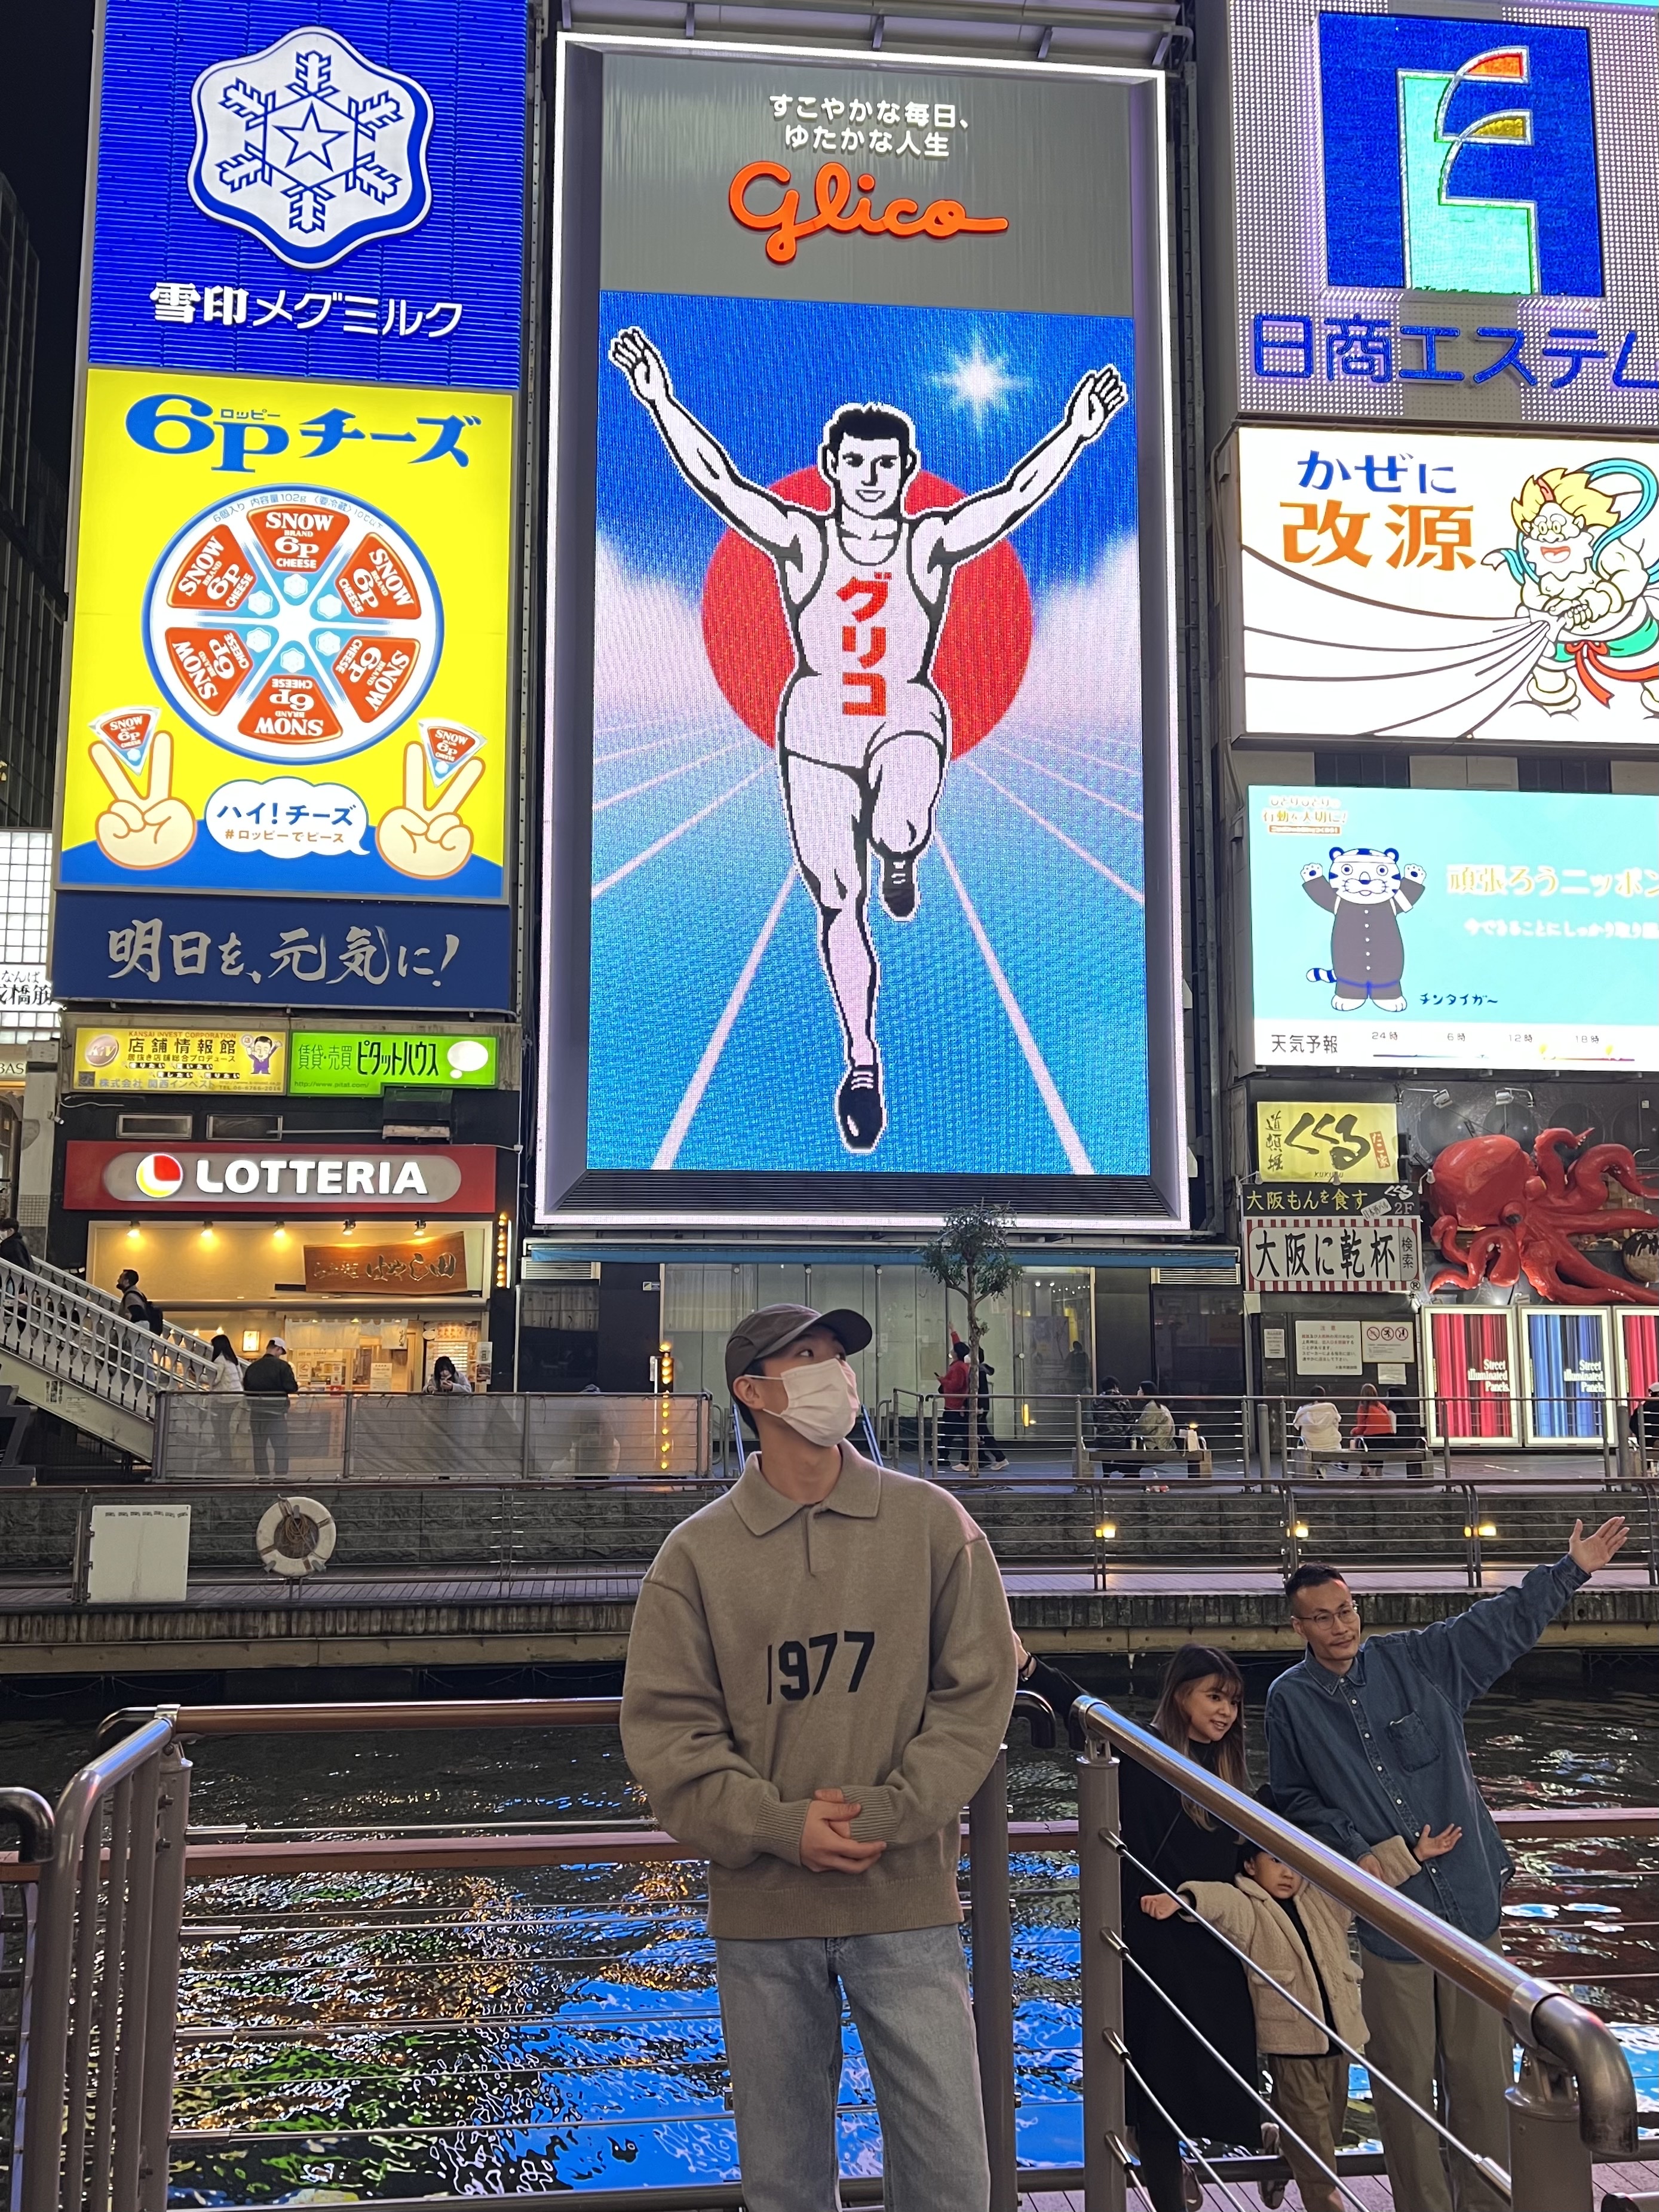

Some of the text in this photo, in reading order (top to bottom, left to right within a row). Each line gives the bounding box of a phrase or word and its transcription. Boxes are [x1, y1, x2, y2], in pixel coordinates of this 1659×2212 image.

[769, 94, 968, 130] すこやかな毎日、
[786, 124, 950, 158] ゆたかな人生
[729, 161, 1010, 263] Glico
[149, 281, 464, 338] 雪印メグミルク
[220, 409, 280, 421] ロッピー
[1297, 449, 1457, 494] かぜに
[213, 503, 246, 523] 6個入り
[266, 511, 334, 531] SNOW
[1280, 499, 1476, 572] 改源
[178, 535, 224, 597] SNOW
[275, 557, 317, 569] CHEESE
[368, 548, 415, 606] SNOW
[225, 572, 253, 608] CHEESE
[339, 578, 364, 615] CHEESE
[223, 632, 250, 669] CHEESE
[335, 639, 363, 674] CHEESE
[836, 572, 892, 717] グリコ
[172, 641, 218, 700] SNOW
[271, 678, 313, 689] CHEESE
[364, 649, 410, 712] SNOW
[109, 716, 143, 731] SNOW
[254, 717, 324, 737] SNOW
[435, 729, 469, 745] SNOW
[1, 970, 40, 984] なんば
[128, 1037, 236, 1054] 店舗情報館
[358, 1040, 439, 1076] ピタットハウス
[1271, 1034, 1338, 1054] 天気予報
[99, 1078, 143, 1089] 株式会社
[1265, 1110, 1284, 1172] 道頓堀
[1284, 1112, 1371, 1171] くくる
[196, 1159, 428, 1196] LOTTERIA
[1247, 1188, 1369, 1211] 大阪もんを食す
[1394, 1202, 1415, 1214] 2F
[1256, 1229, 1395, 1280] 大阪に乾杯
[1402, 1237, 1413, 1269] 検索
[1483, 1358, 1505, 1370] Street
[1579, 1359, 1602, 1371] Street
[766, 1630, 875, 1705] 1977
